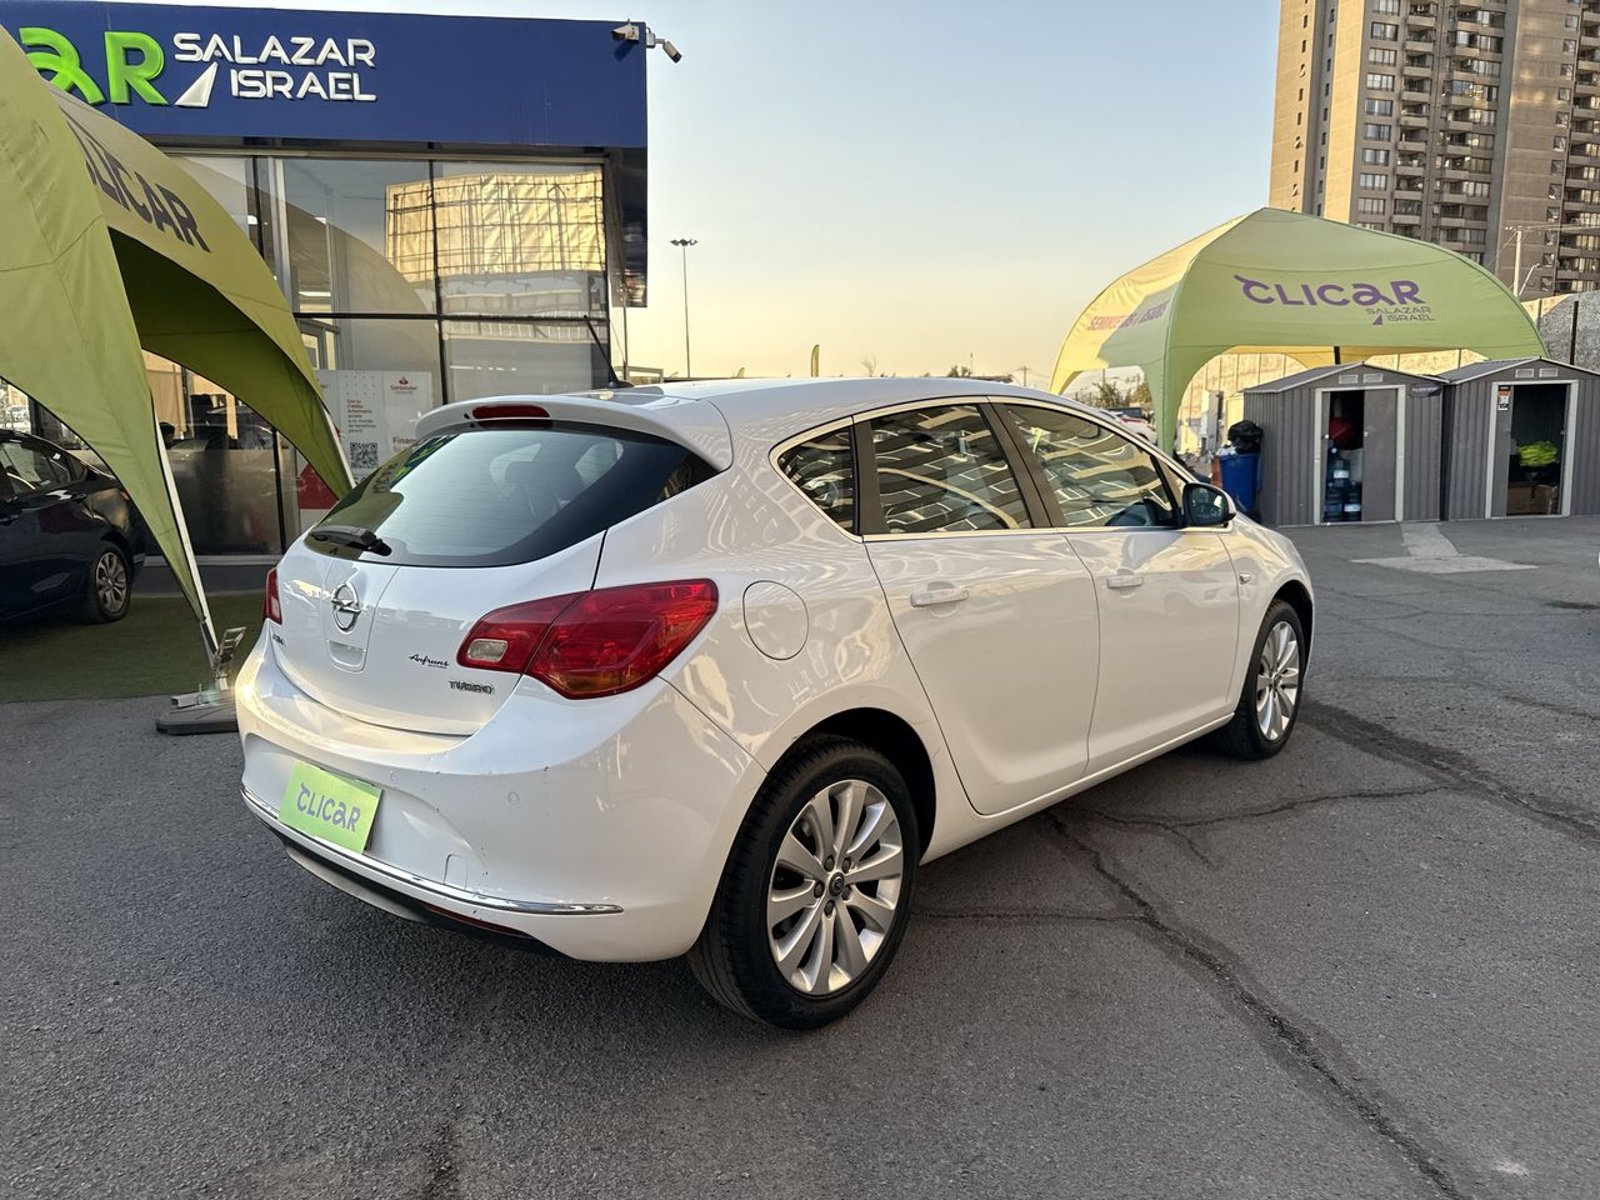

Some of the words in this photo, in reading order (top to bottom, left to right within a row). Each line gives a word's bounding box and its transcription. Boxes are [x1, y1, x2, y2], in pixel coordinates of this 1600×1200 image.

[174, 32, 376, 67] SALAZAR
[230, 69, 377, 101] ISRAEL
[1365, 306, 1431, 315] SALAZAR
[1387, 313, 1437, 321] ISRAEL
